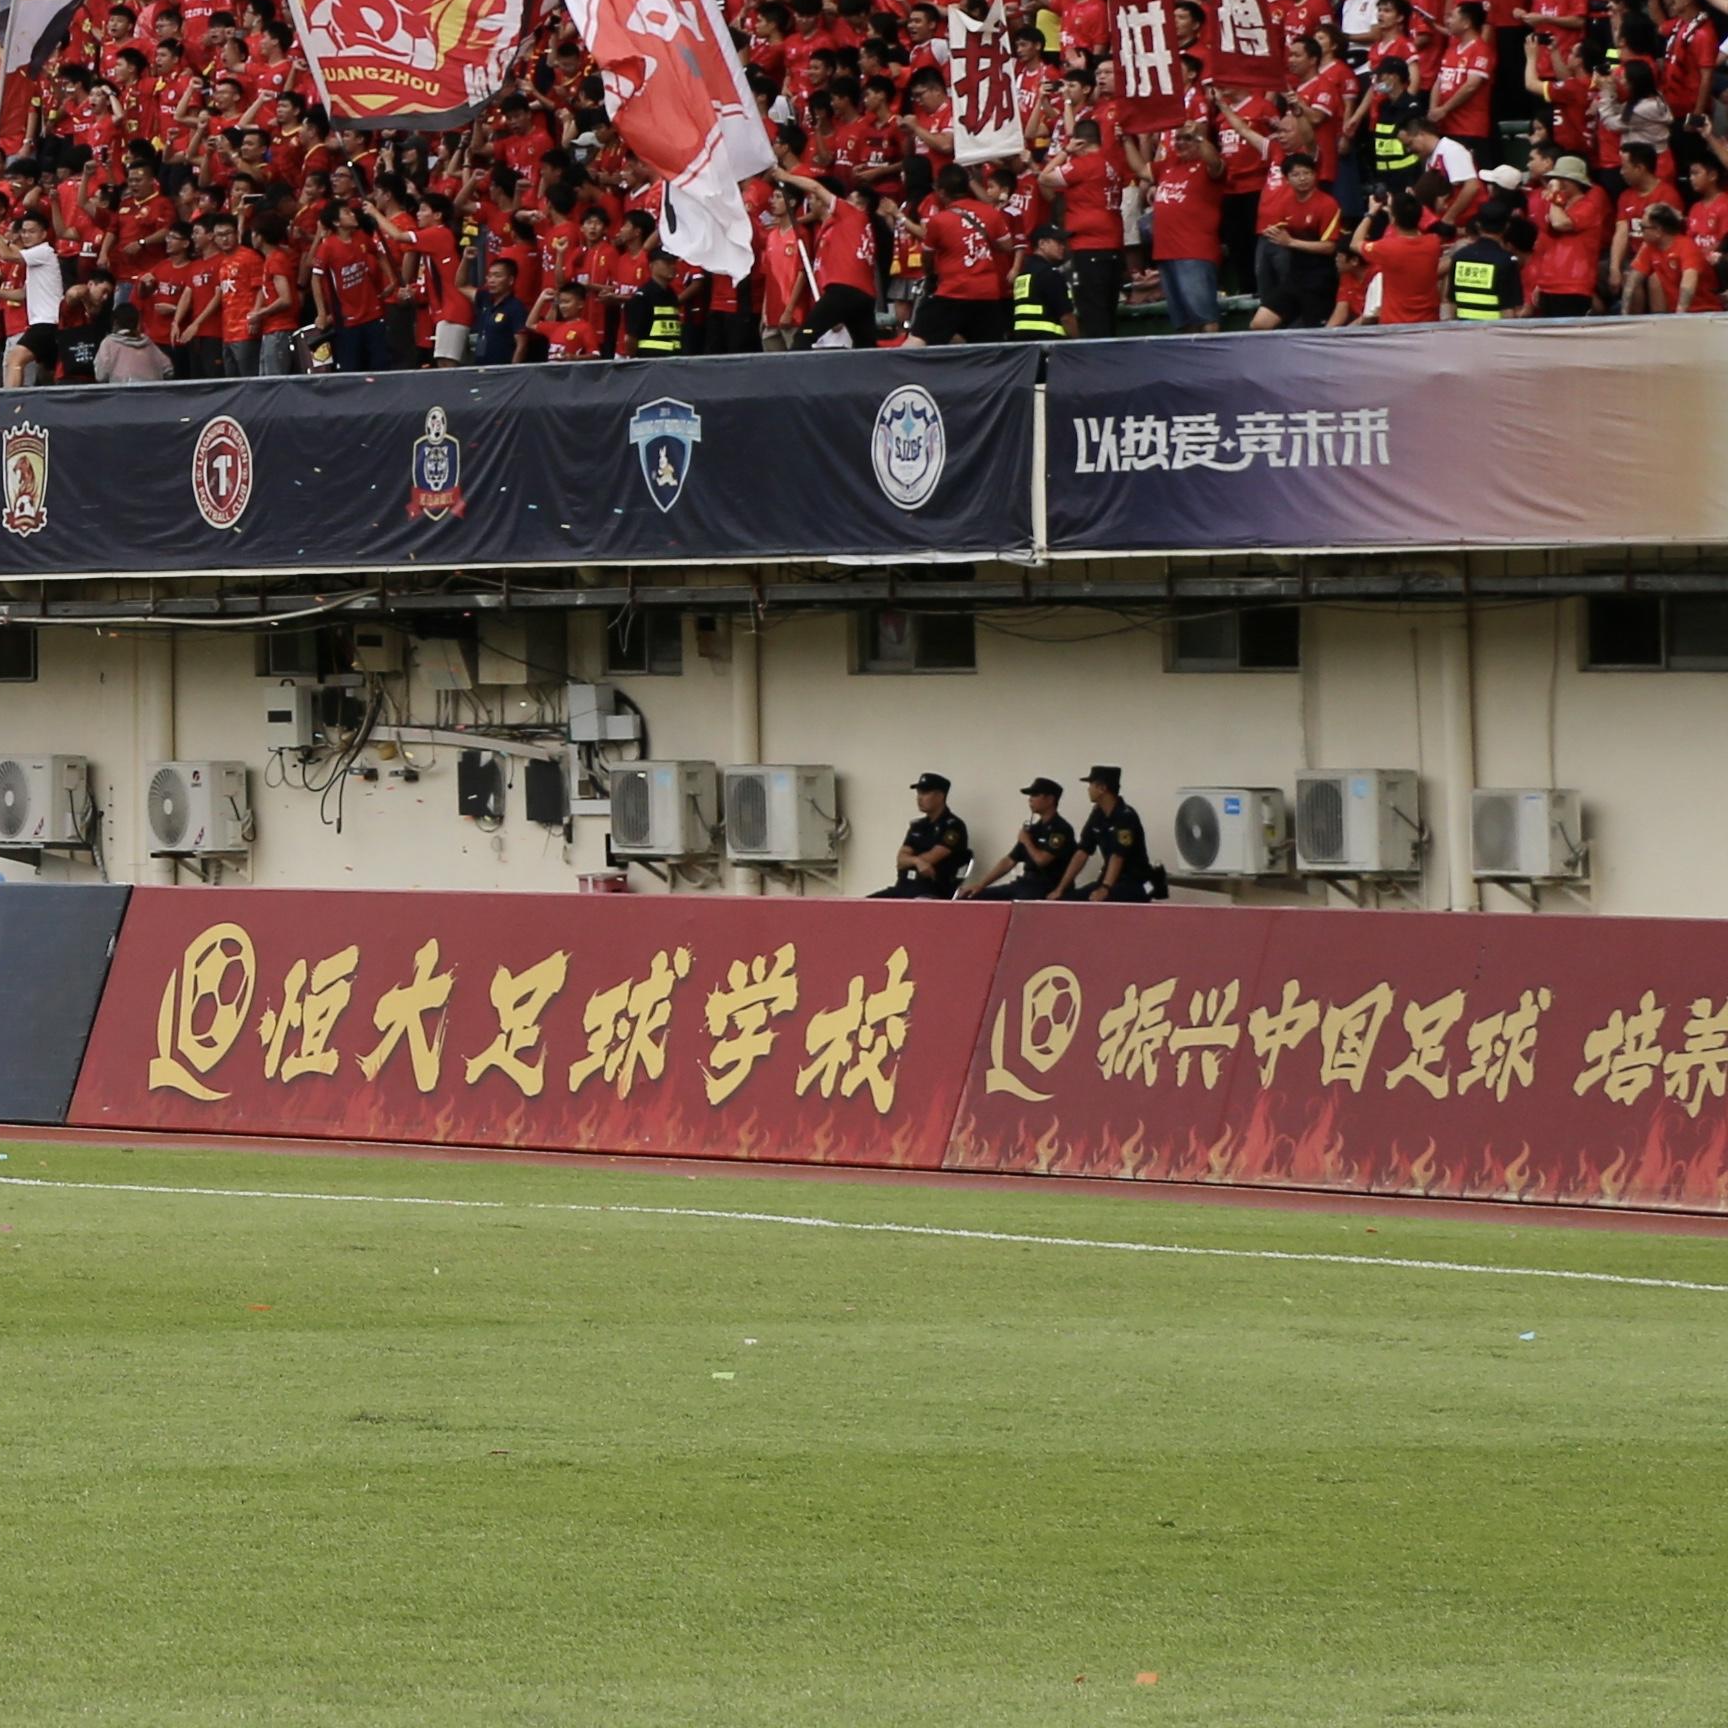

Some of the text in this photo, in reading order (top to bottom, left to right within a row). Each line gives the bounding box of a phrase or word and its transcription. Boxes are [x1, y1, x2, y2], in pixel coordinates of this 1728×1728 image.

[257, 936, 917, 1115] 恒大足球学校
[1096, 976, 1553, 1102] 振兴中国足球
